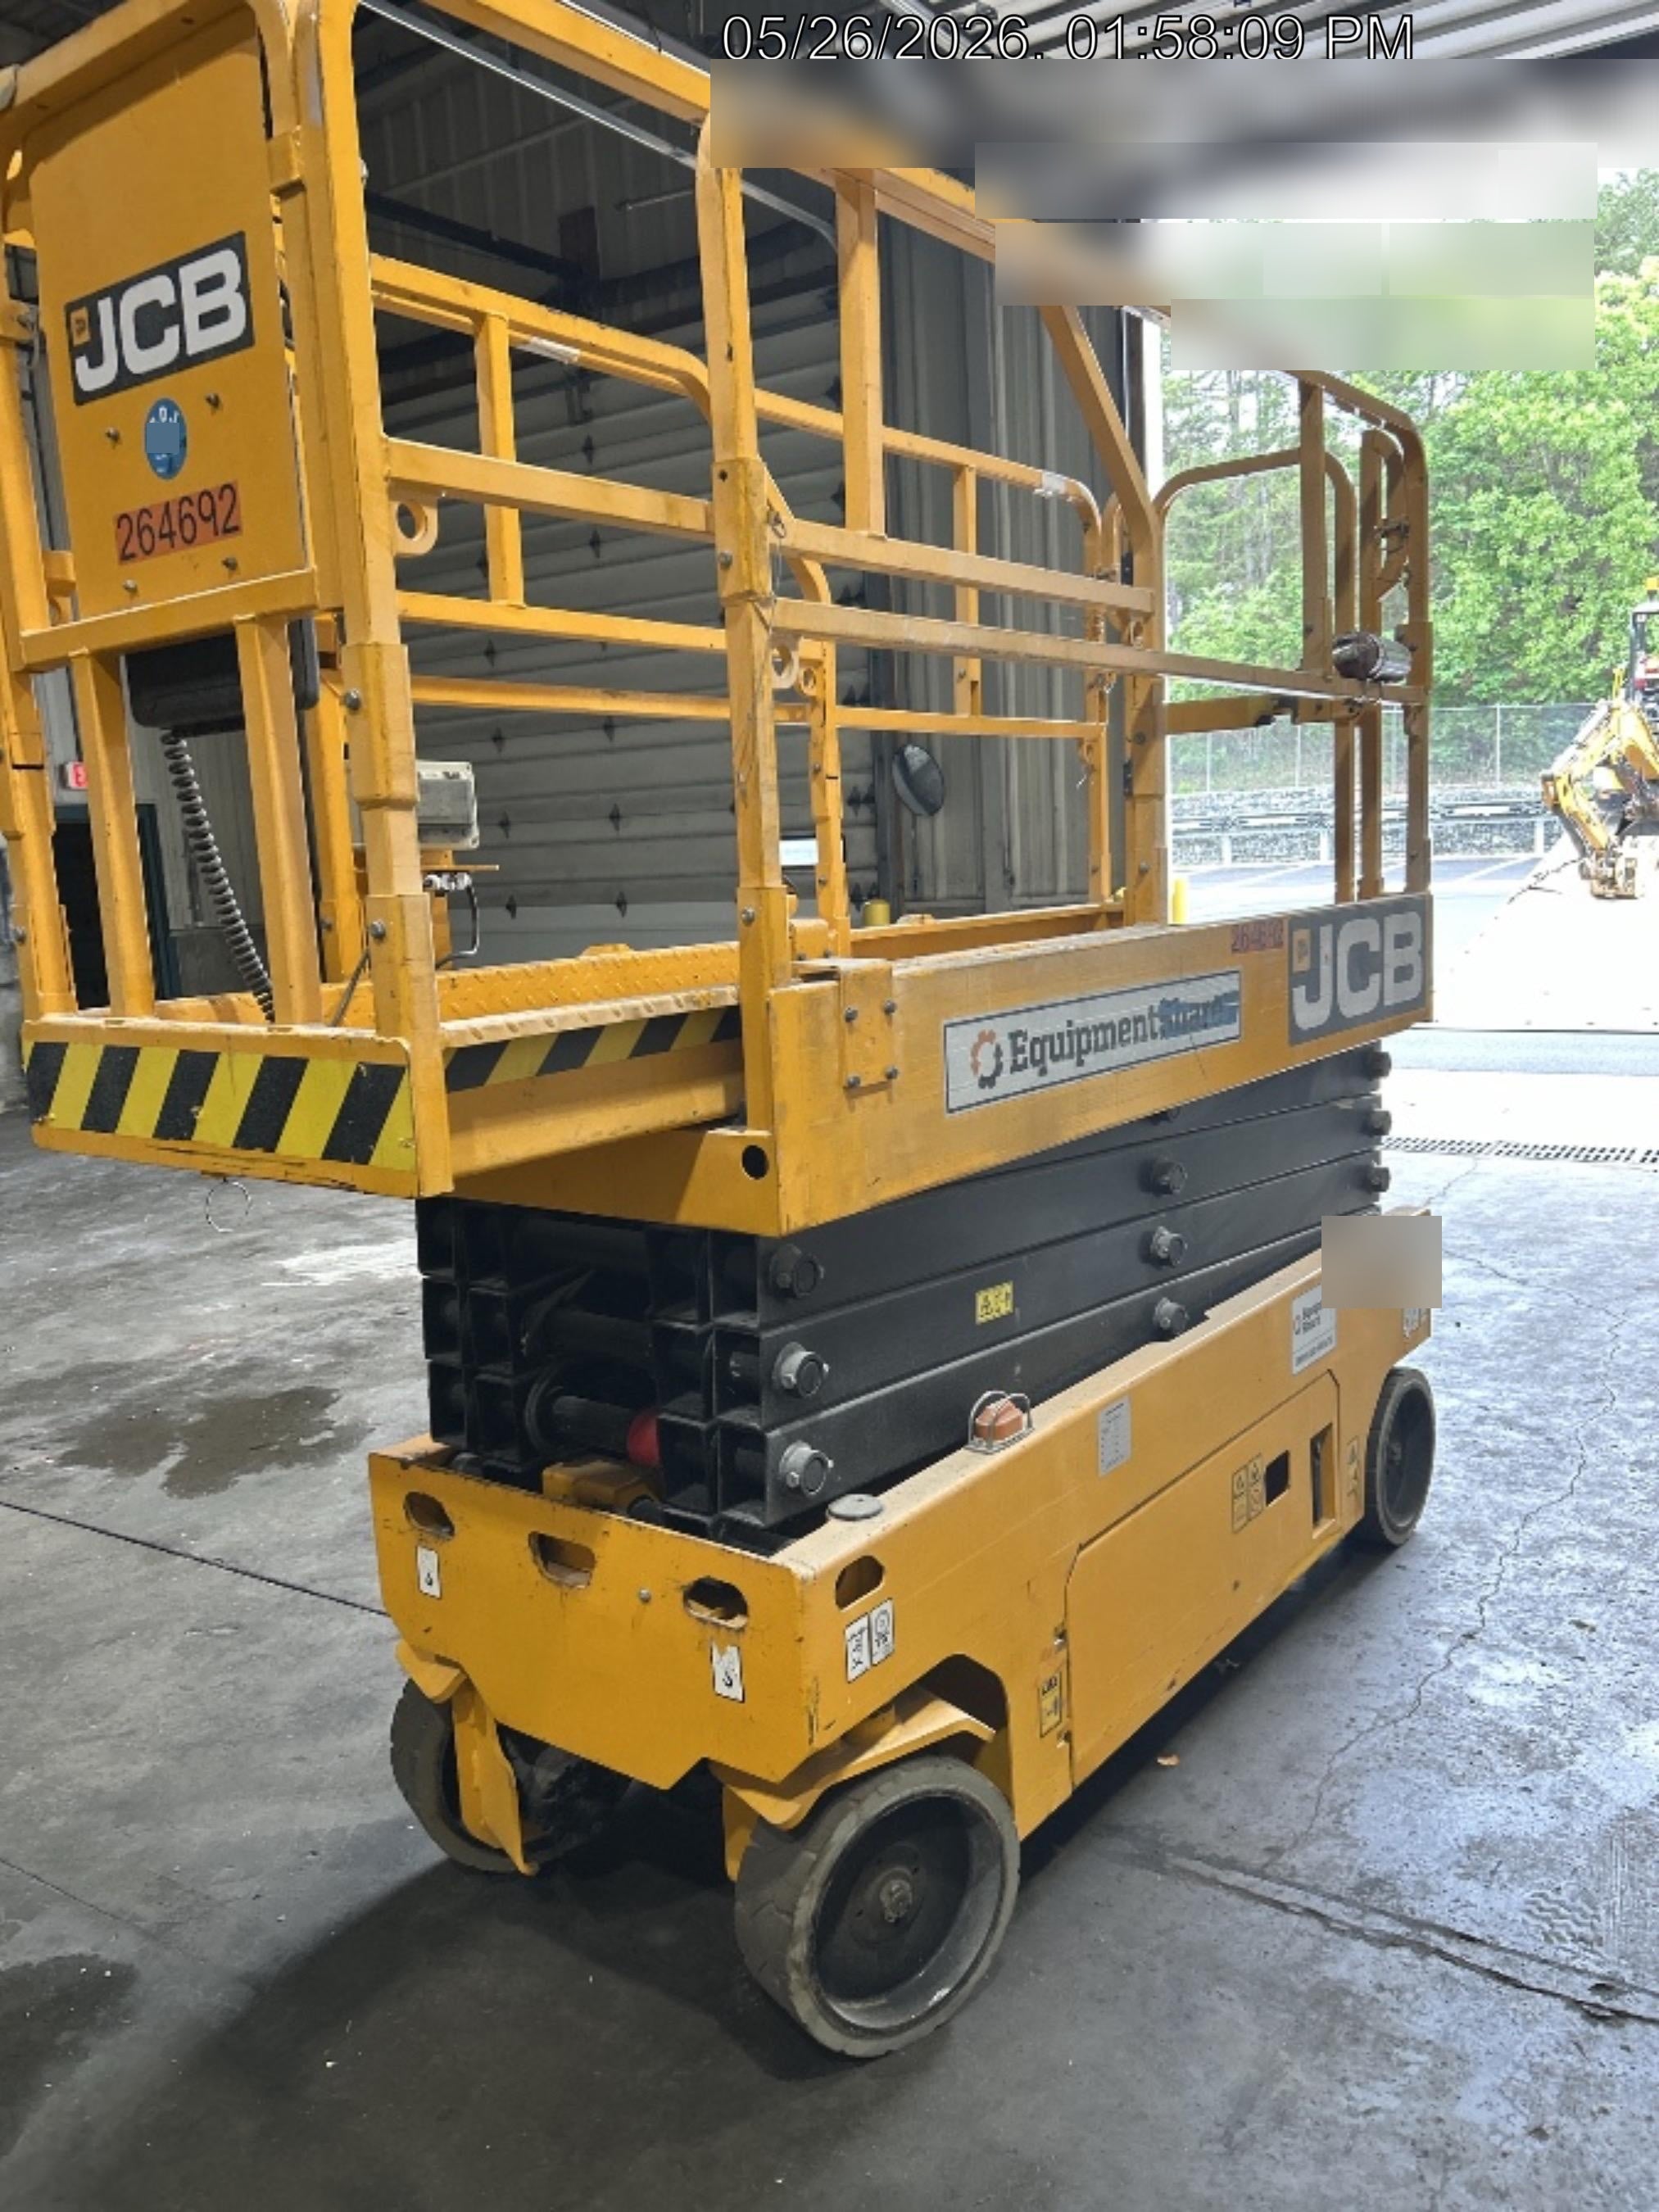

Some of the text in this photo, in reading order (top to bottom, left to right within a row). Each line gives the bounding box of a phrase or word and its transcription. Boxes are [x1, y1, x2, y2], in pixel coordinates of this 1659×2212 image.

[75, 249, 247, 392] JCB
[116, 483, 241, 562] 264692
[1292, 910, 1424, 1031] JCB
